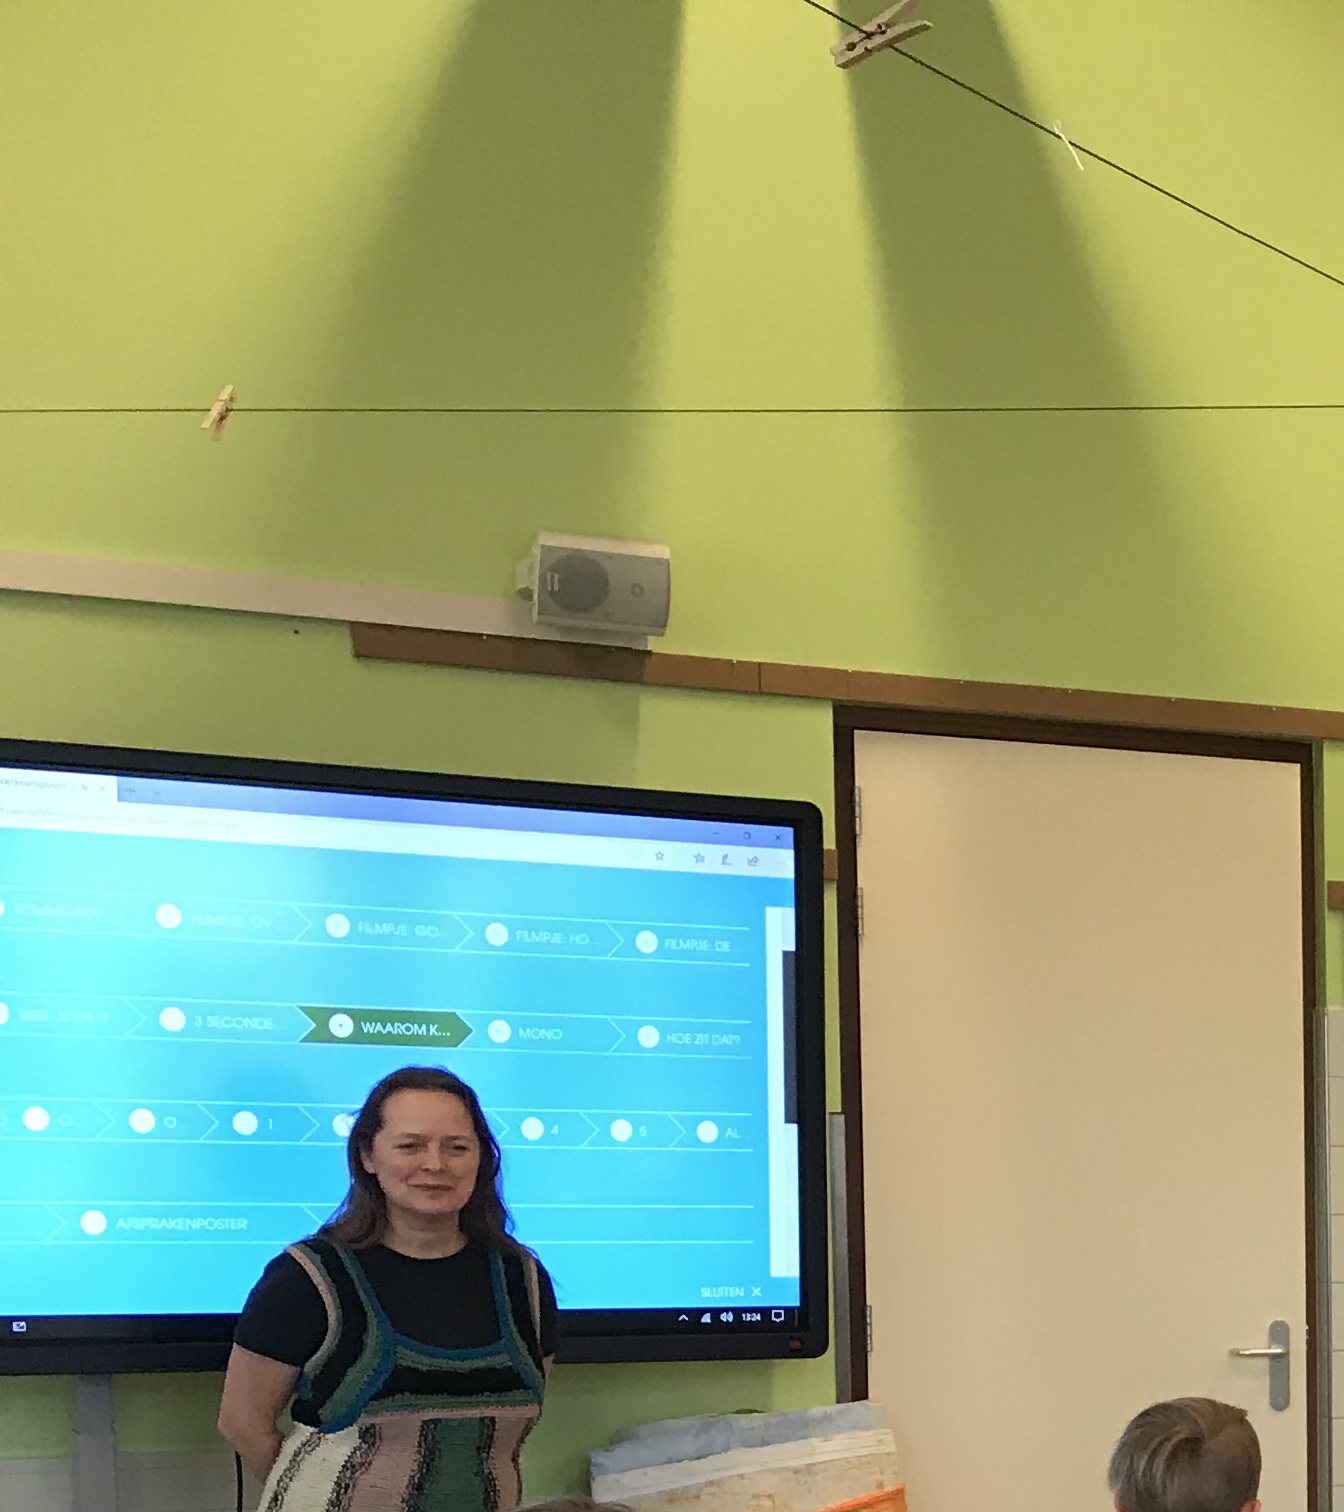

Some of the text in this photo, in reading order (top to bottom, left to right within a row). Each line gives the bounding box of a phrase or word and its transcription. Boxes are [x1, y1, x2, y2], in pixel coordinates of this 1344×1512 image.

[361, 1021, 426, 1036] WAAROM
[518, 1026, 562, 1041] MONO
[666, 1033, 692, 1045] HOE
[550, 1124, 559, 1136] 4
[640, 1126, 647, 1137] 5
[115, 1216, 248, 1231] AFSPRAKENPOSTER
[700, 1286, 744, 1298] SLUITEN
